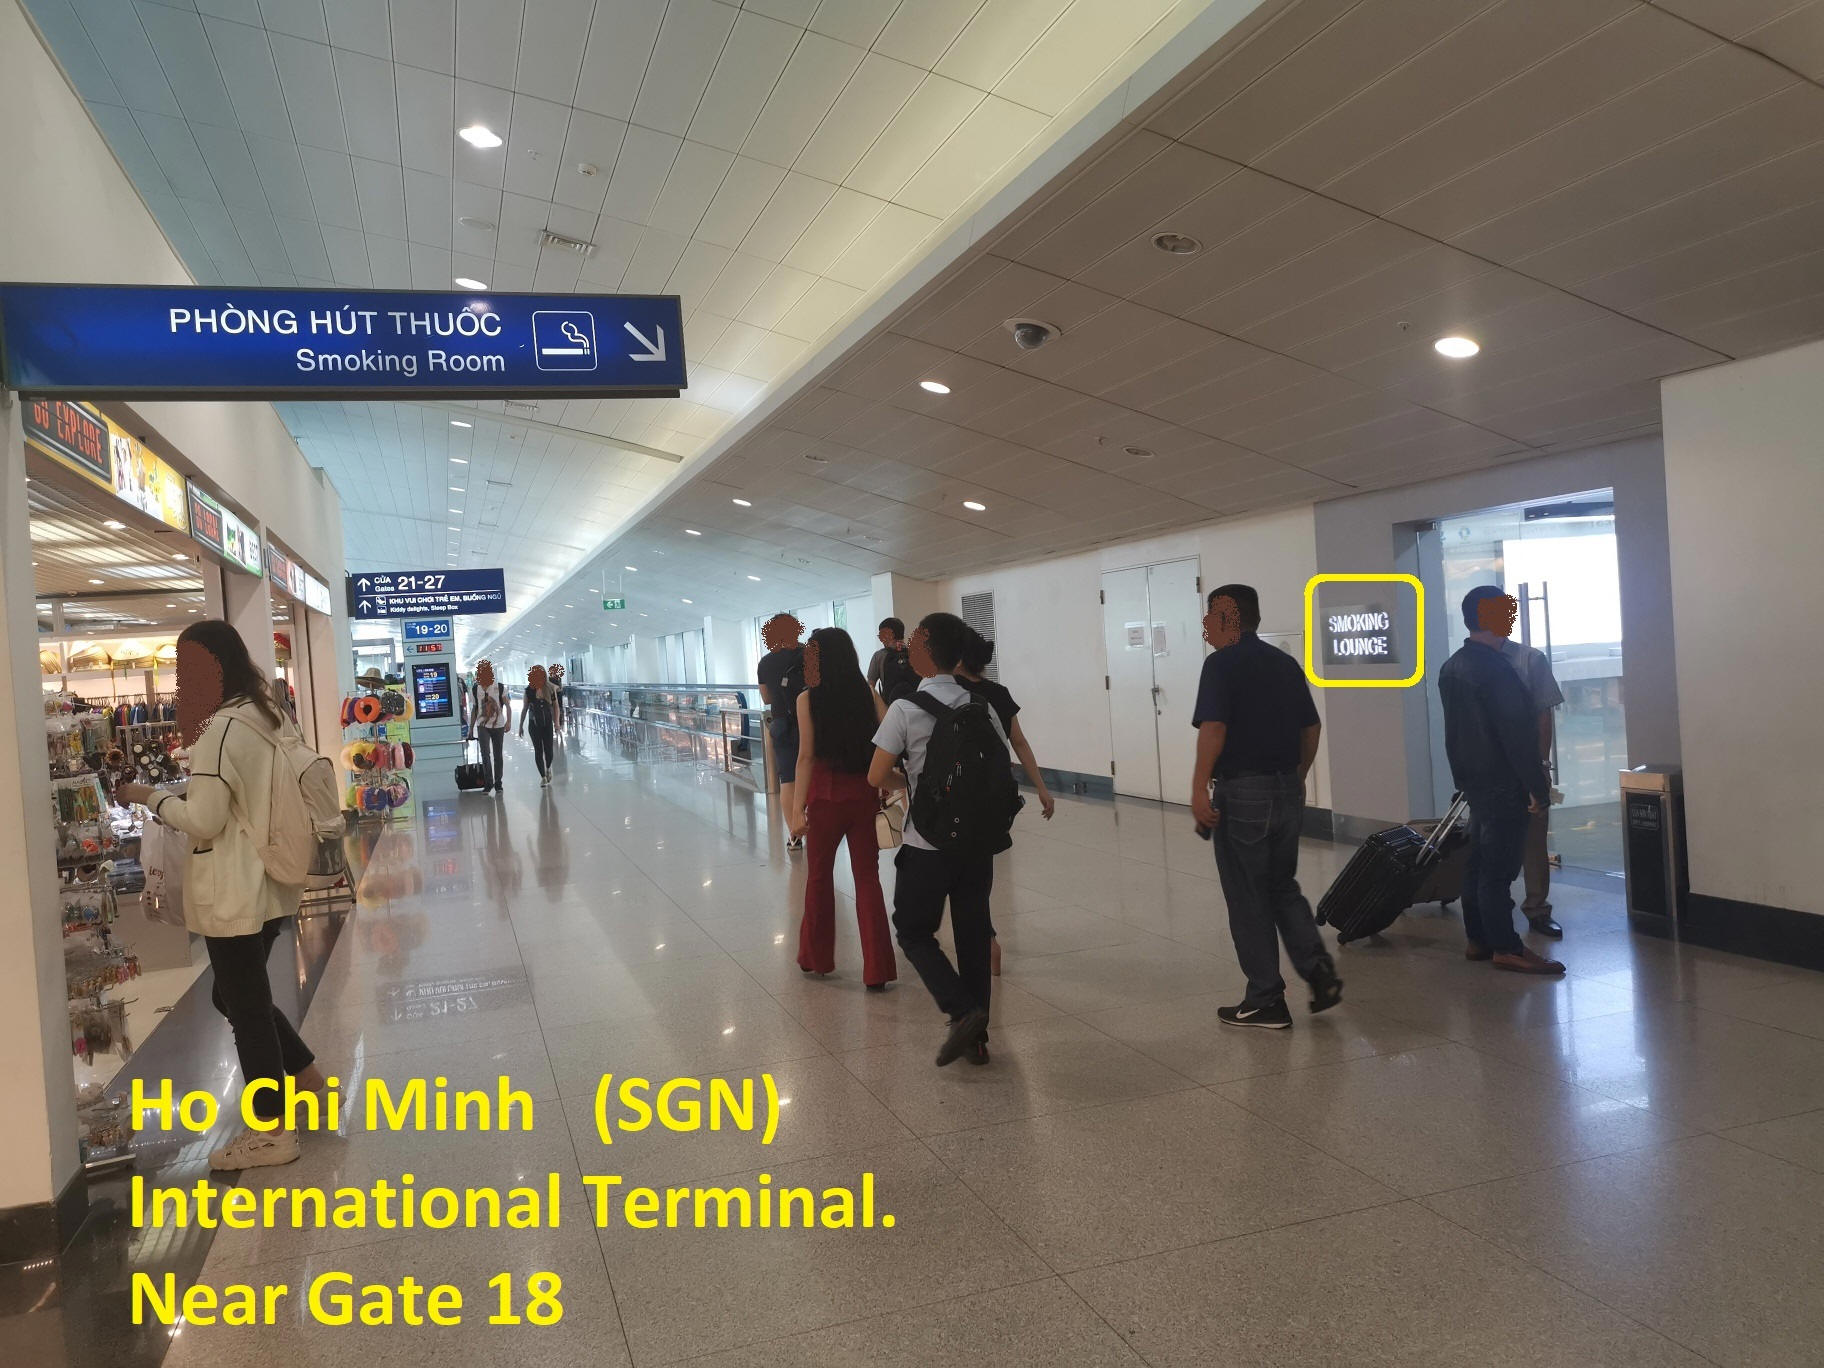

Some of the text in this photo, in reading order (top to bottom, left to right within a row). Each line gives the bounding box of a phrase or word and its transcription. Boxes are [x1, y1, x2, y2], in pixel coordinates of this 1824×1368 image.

[169, 302, 298, 335] PHÒNG
[310, 304, 378, 335] HÚT
[296, 348, 505, 377] Smoking Room
[397, 575, 446, 590] 21-27
[415, 624, 448, 635] 19-20
[1328, 611, 1390, 633] SMOKING
[1333, 636, 1388, 656] LOUNGE
